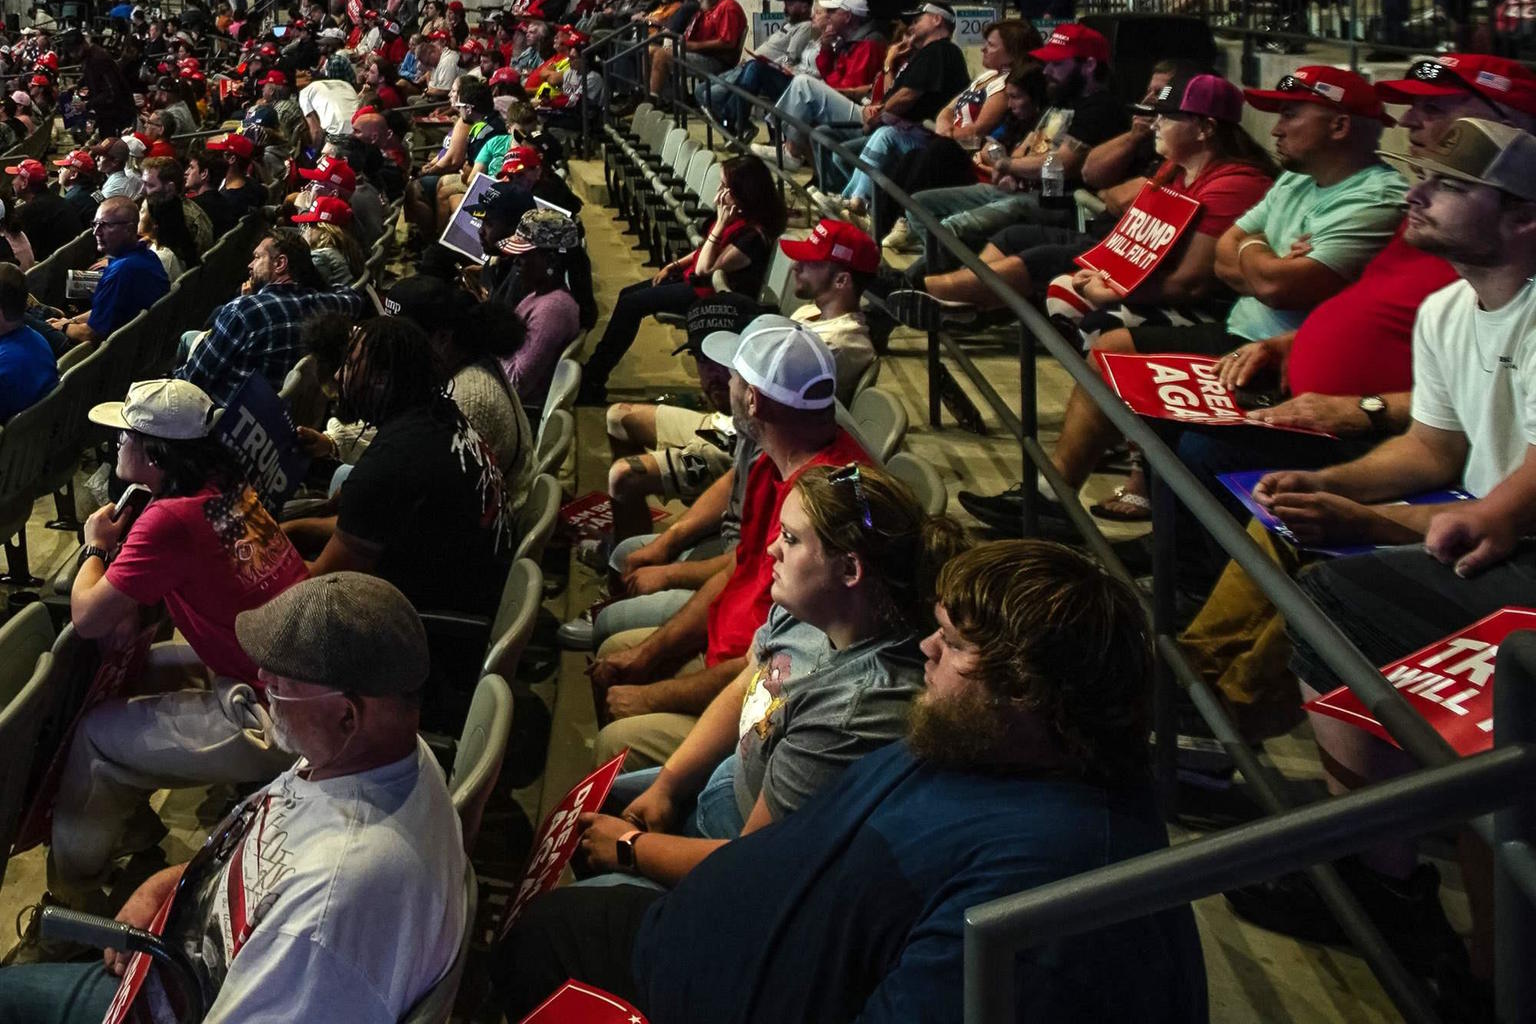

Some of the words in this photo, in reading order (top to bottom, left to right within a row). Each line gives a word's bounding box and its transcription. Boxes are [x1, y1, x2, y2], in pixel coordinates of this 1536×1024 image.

[1120, 207, 1176, 251] TRUMP
[1106, 233, 1132, 256] WILL
[1124, 243, 1148, 265] FIX
[1138, 252, 1158, 270] IT
[700, 304, 738, 316] AMERICA
[706, 318, 735, 328] AGAIN
[1146, 362, 1211, 423] AGA
[1190, 362, 1241, 422] DREA
[232, 405, 287, 493] TRUMP
